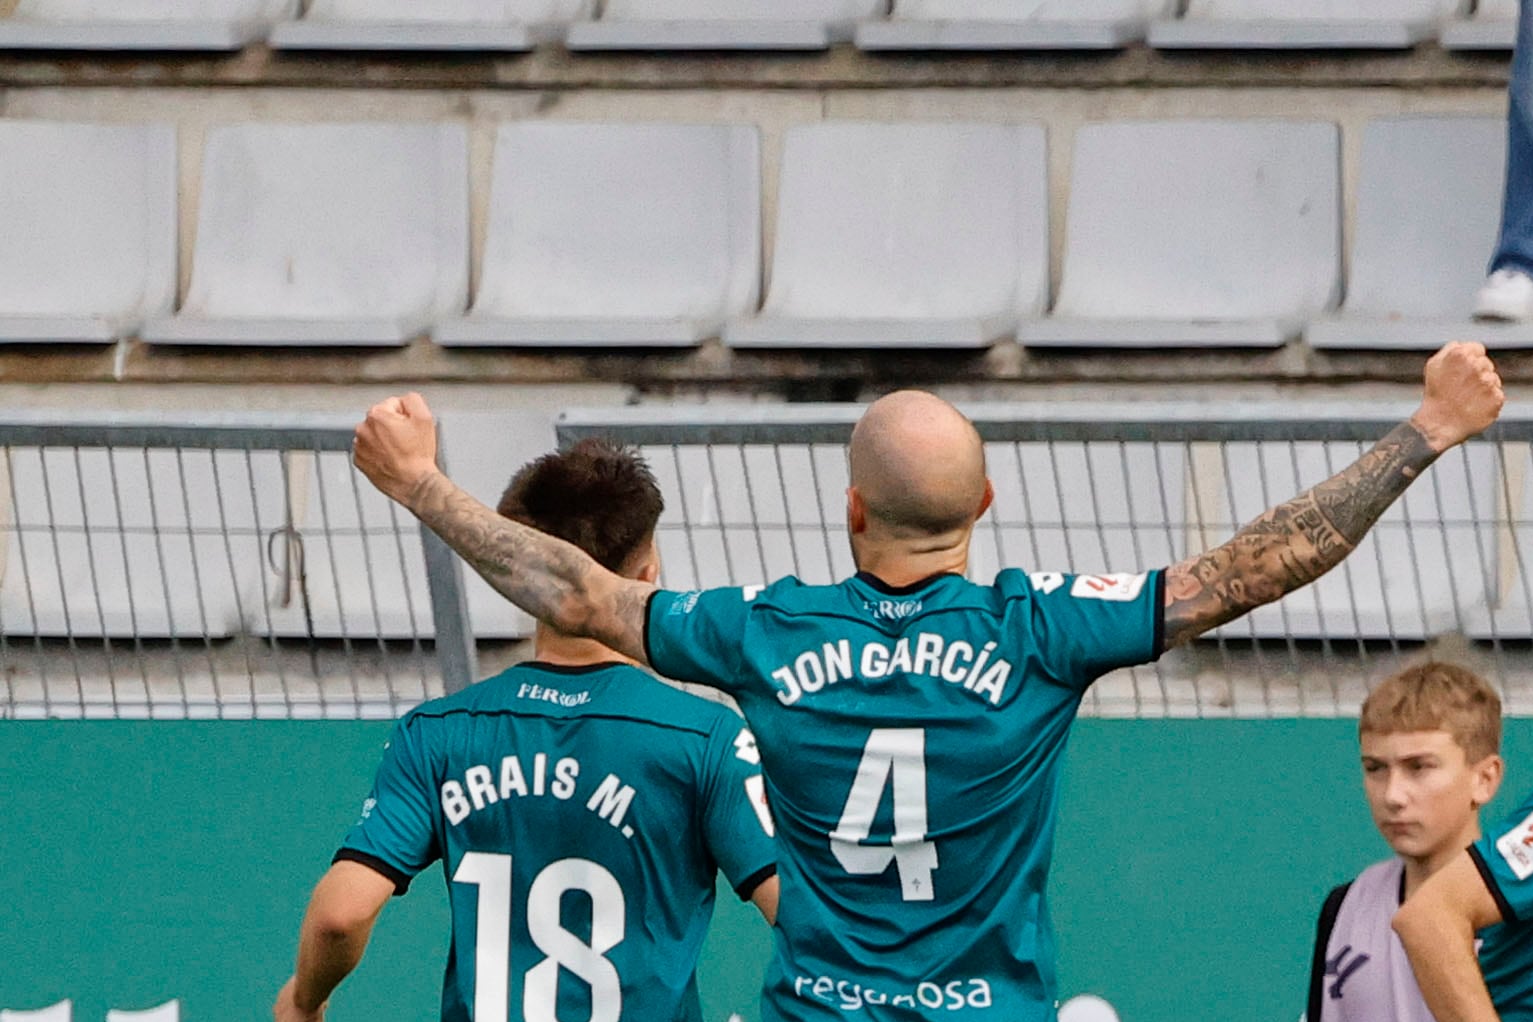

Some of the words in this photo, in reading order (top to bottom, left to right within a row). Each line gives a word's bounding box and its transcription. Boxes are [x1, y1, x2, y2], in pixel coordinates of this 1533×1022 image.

[771, 638, 853, 706] JON
[859, 631, 1013, 705] GARCÍA
[440, 752, 581, 827] BRAIS
[585, 772, 637, 840] M.
[828, 727, 939, 901] 4
